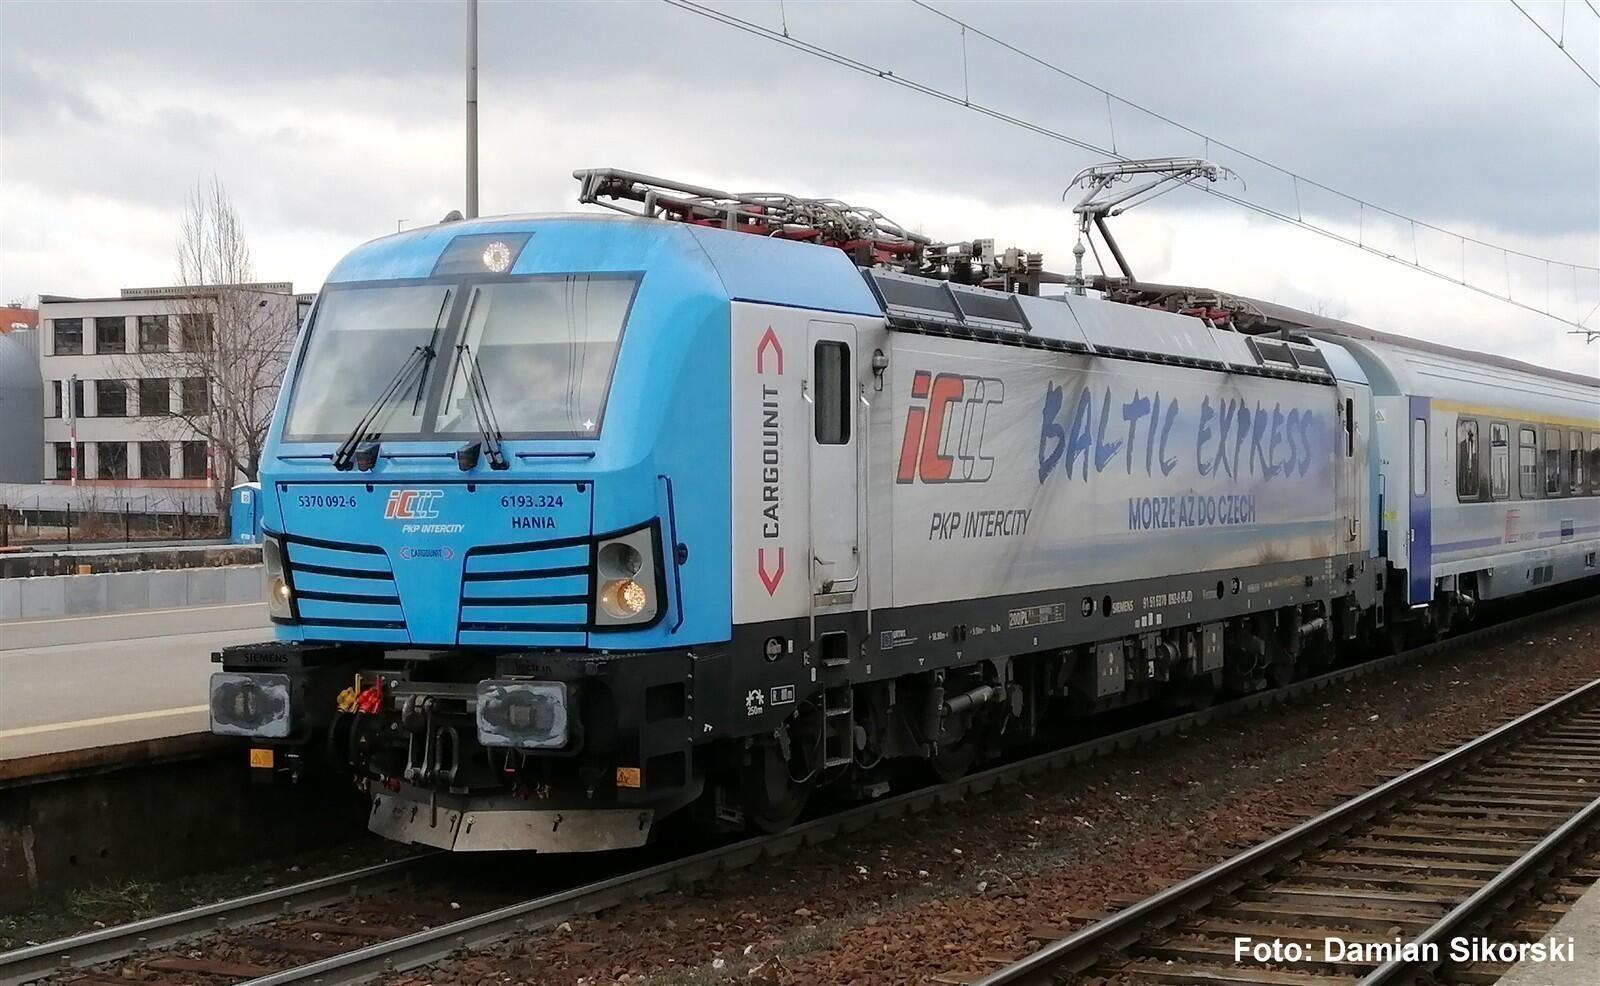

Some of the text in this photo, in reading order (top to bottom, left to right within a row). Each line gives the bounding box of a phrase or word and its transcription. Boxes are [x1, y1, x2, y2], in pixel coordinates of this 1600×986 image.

[1038, 380, 1313, 485] BALTIC EXPRESS
[762, 383, 779, 539] CARGOUNIT
[298, 495, 357, 508] 5370 092-6
[500, 495, 564, 508] 6193.324
[1129, 496, 1176, 530] MORZE
[1198, 496, 1216, 526] DO
[1218, 494, 1256, 525] CZECH
[402, 524, 465, 534] PKP INTERCITY
[511, 516, 556, 529] HANIA
[929, 508, 1032, 541] PKP INTERCITY
[1112, 599, 1135, 614] SIEMENS
[243, 652, 289, 664] SIEMENS
